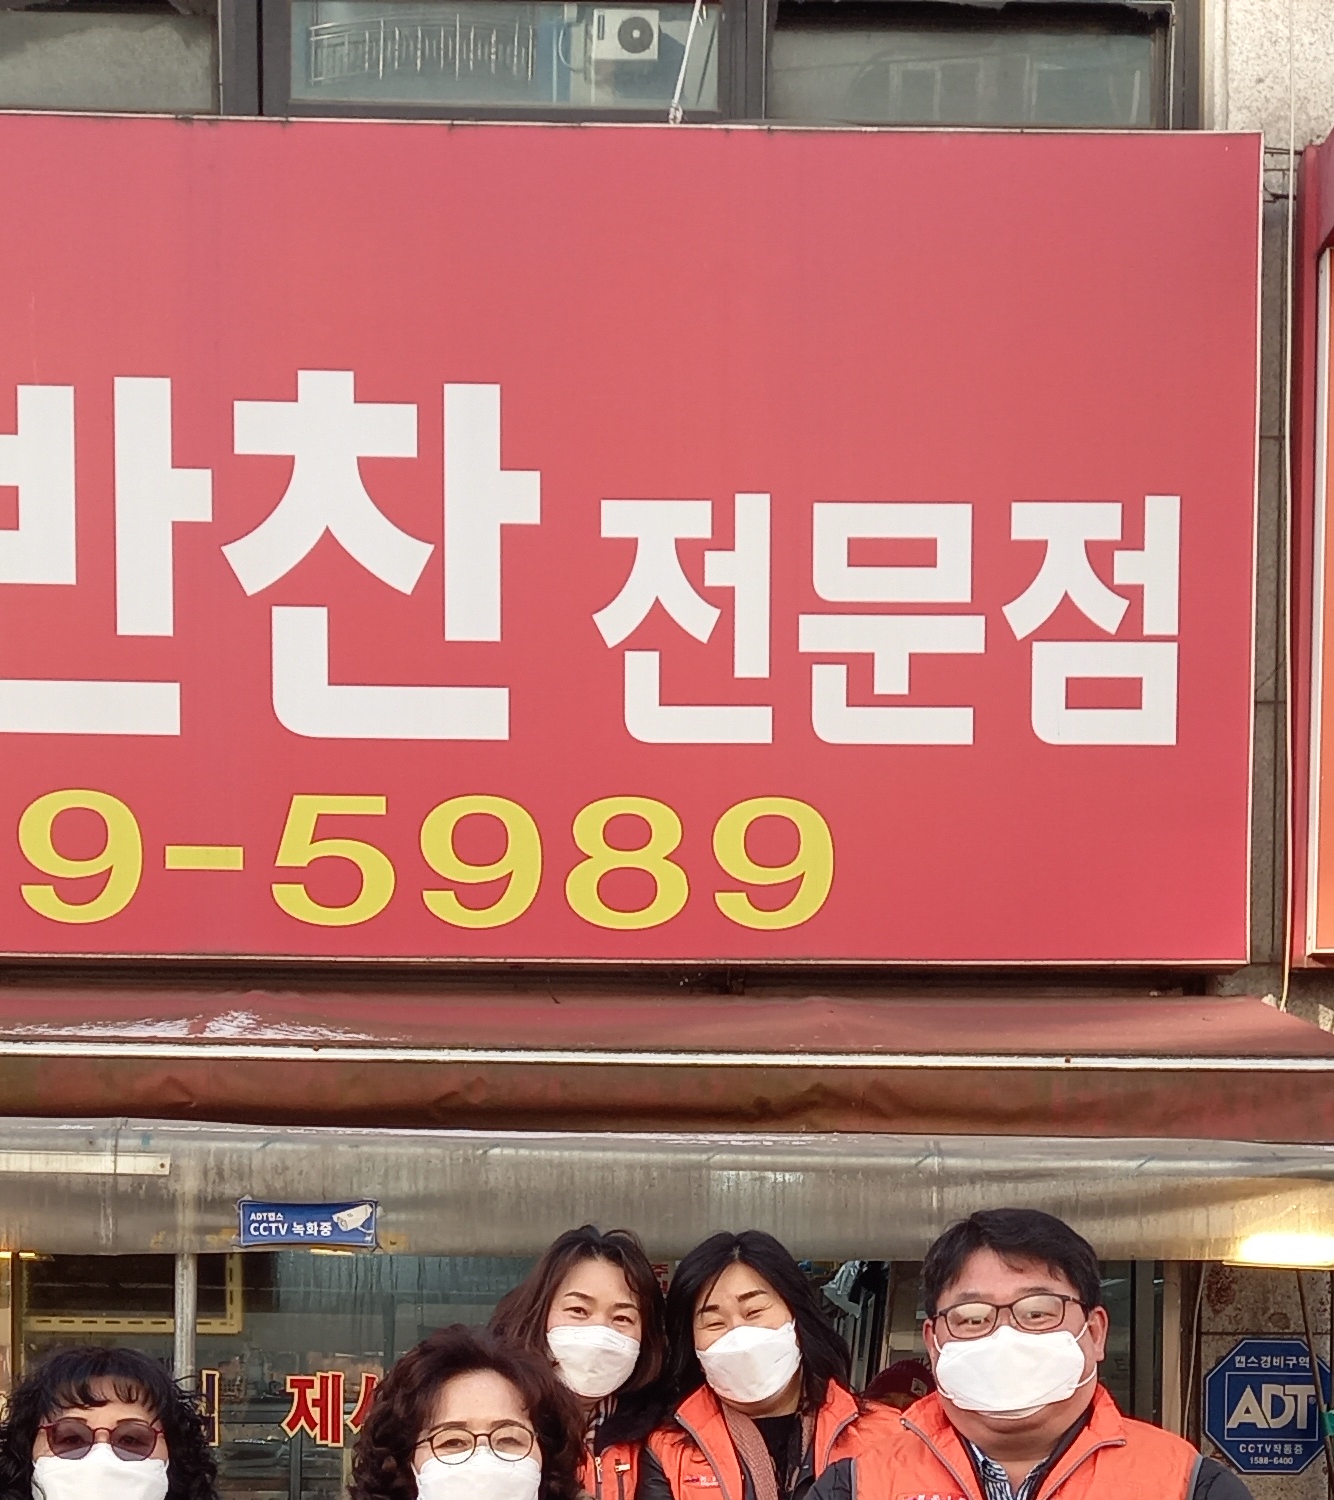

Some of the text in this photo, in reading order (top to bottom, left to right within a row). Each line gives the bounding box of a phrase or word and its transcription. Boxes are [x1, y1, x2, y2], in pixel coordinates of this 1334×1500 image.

[592, 493, 1181, 746] 전문점
[250, 1221, 333, 1237] CCTV 녹화중
[1234, 1355, 1310, 1369] 캡스경비구역
[1227, 1384, 1317, 1430] ADT
